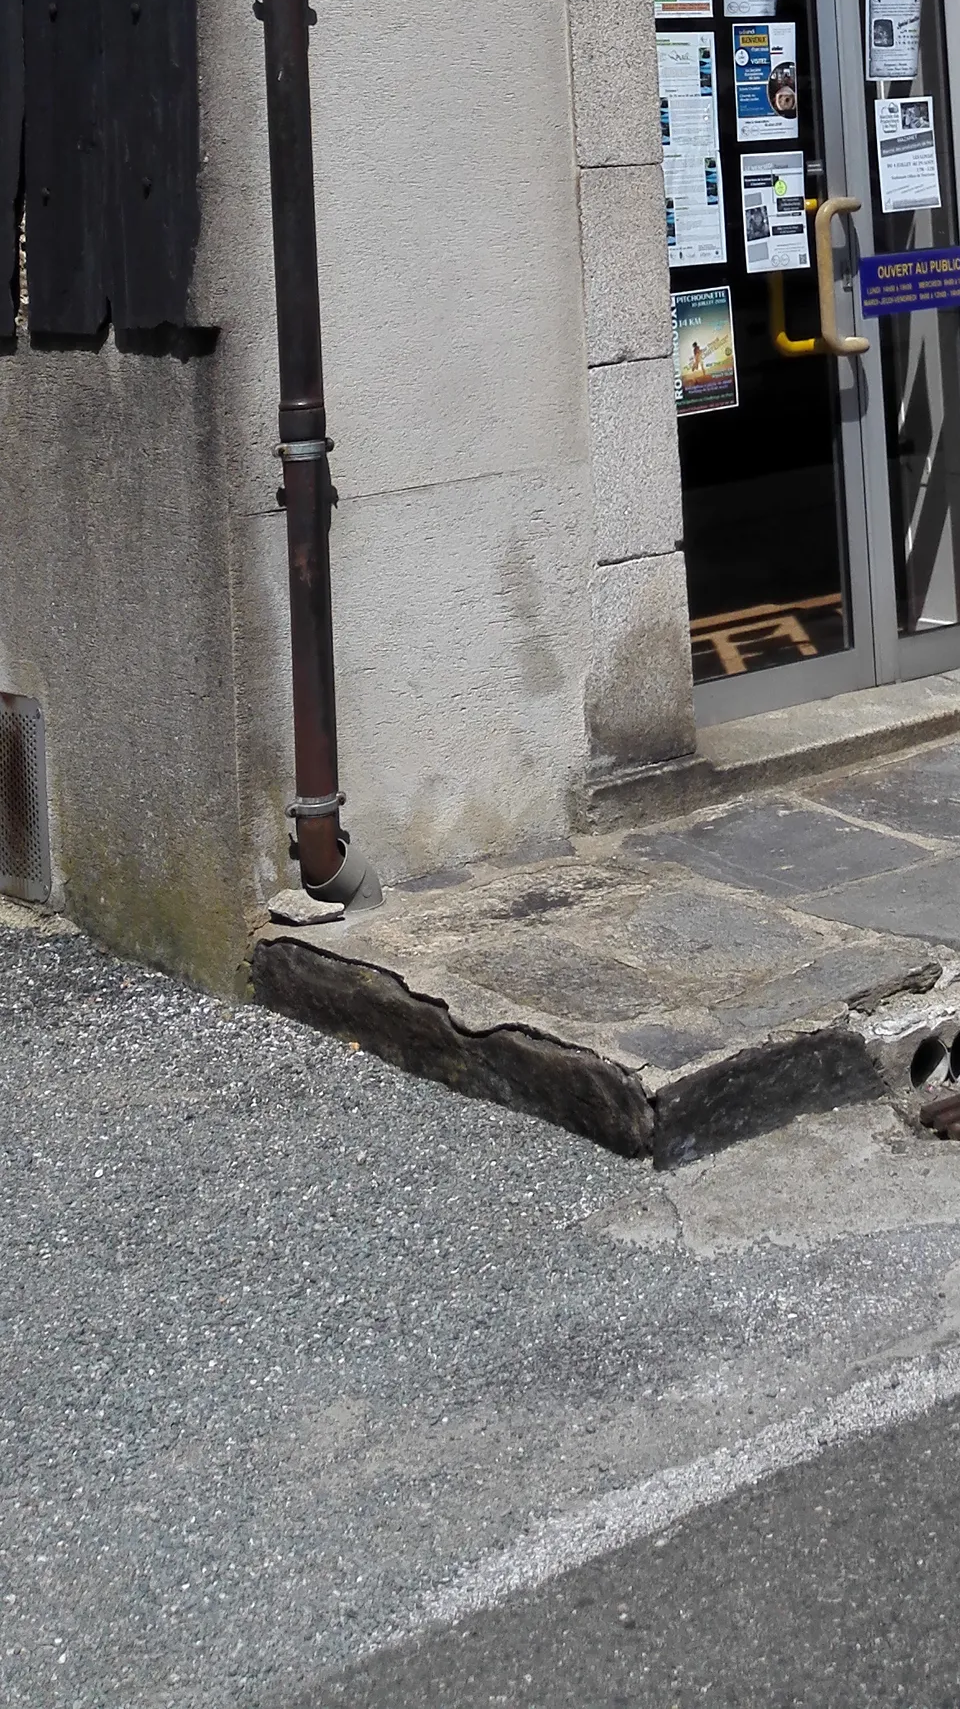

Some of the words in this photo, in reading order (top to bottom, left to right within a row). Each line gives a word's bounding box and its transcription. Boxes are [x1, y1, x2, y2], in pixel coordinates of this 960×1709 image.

[877, 262, 914, 279] OUVERT
[915, 261, 928, 275] AU
[676, 290, 726, 304] PITCHOUNETTE
[678, 319, 687, 328] 14
